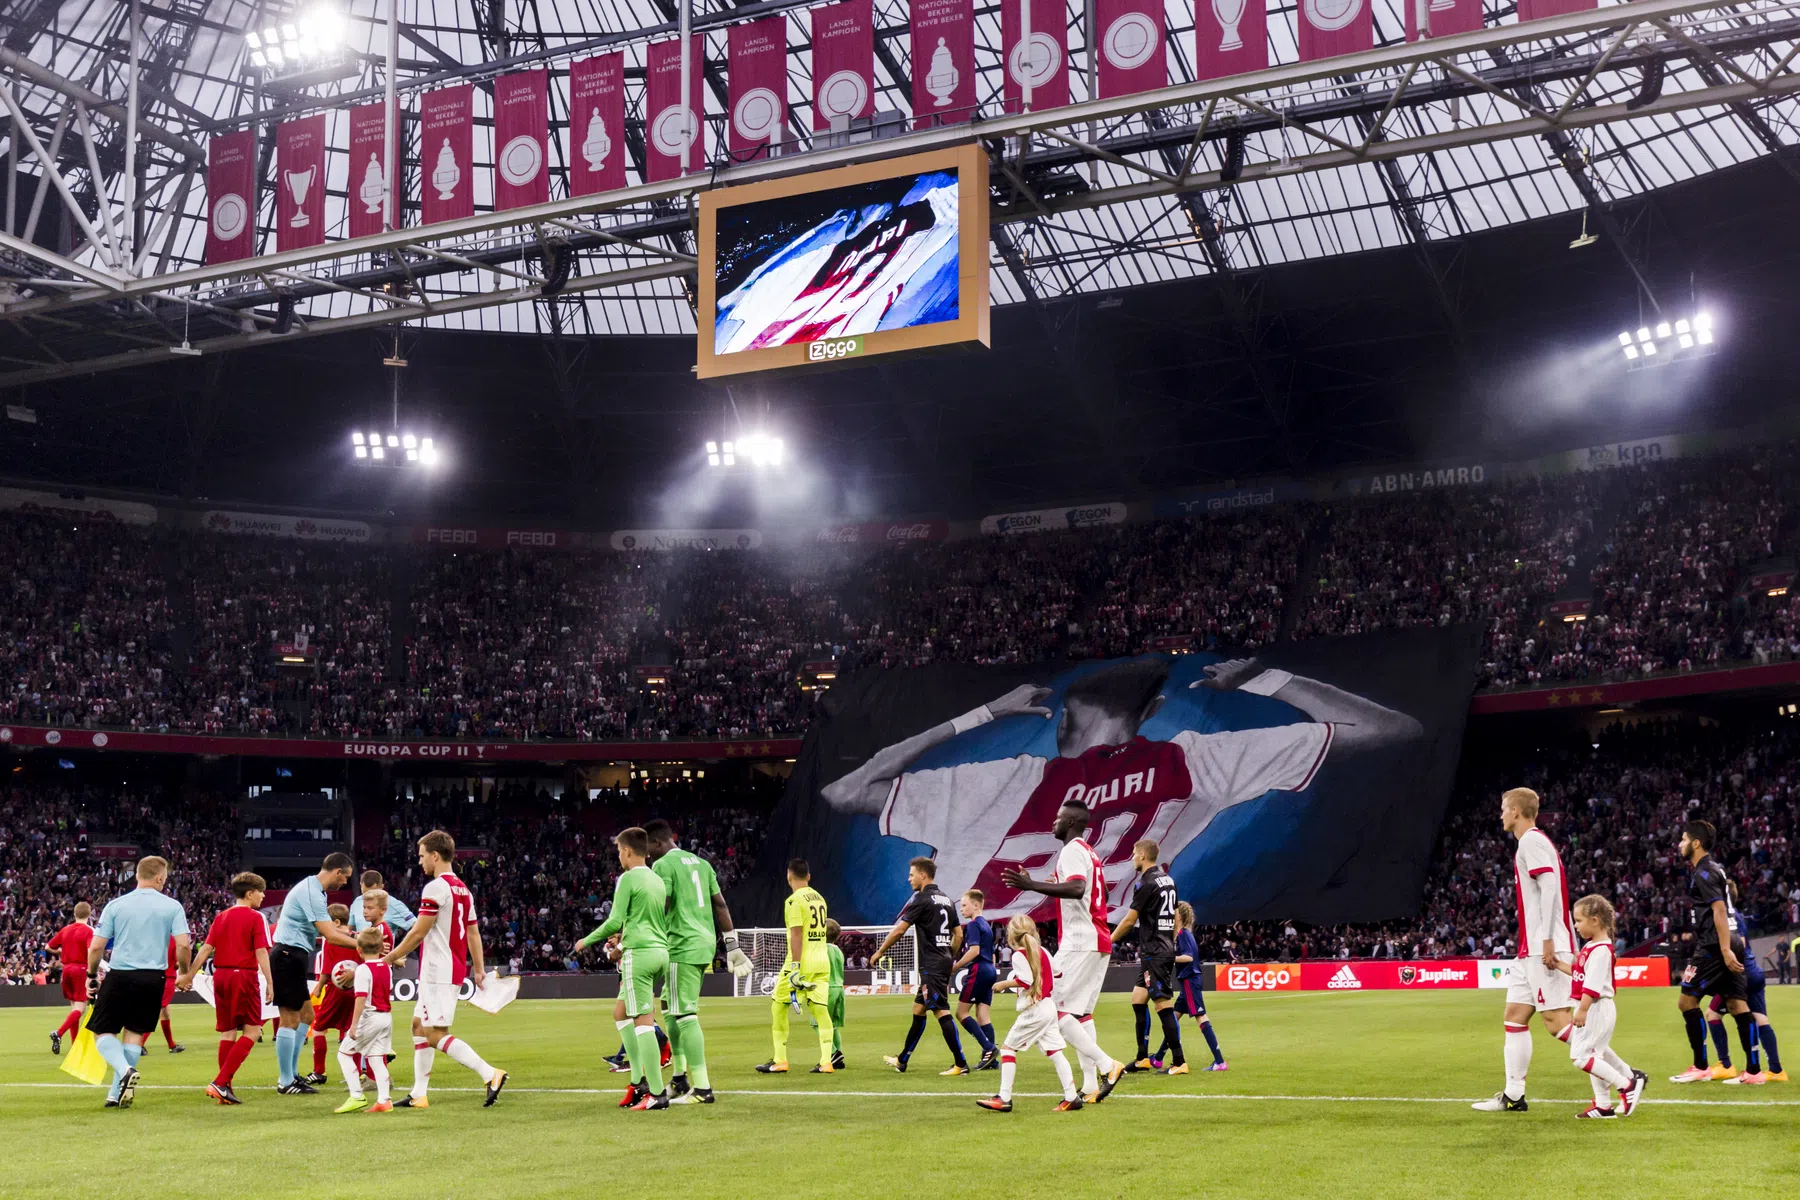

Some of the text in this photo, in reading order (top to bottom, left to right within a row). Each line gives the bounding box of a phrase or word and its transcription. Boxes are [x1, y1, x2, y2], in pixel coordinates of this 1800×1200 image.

[829, 18, 854, 29] LANDS
[917, 13, 964, 28] KNVB BEKER
[822, 26, 861, 39] KAMPIOEN
[744, 36, 768, 47] LANDS
[738, 44, 775, 57] KAMPIOEN
[663, 54, 682, 65] LAND
[577, 69, 615, 82] NATIONALE
[509, 86, 532, 97] LANDS
[575, 85, 616, 99] KNVB BEKER
[503, 94, 536, 106] KAMPIOEN
[427, 101, 465, 114] NATIONALE
[356, 118, 385, 129] NATIONA
[427, 116, 465, 130] KNVB BEKER
[289, 133, 312, 143] EUROPA
[355, 134, 372, 144] KNVB
[291, 141, 304, 150] CUP
[220, 148, 240, 157] LANDS
[215, 154, 244, 165] KAMPIOEN
[1618, 442, 1661, 464] kpn
[1207, 487, 1274, 510] randstad
[1074, 508, 1112, 521] AEGON
[235, 519, 281, 531] HUAWEI
[1004, 515, 1042, 529] AEGON
[320, 526, 366, 537] HUAWEI
[427, 528, 477, 544] FEBO
[507, 531, 556, 546] FEBO
[344, 744, 412, 756] EUROPA
[418, 745, 451, 757] CUP
[457, 746, 468, 756] II
[691, 870, 705, 908] 1
[1095, 867, 1102, 907] 5
[1159, 889, 1176, 916] 20
[809, 904, 827, 929] 30
[939, 908, 950, 934] 2
[1228, 966, 1290, 989] Ziggo
[1327, 979, 1362, 989] adidas
[1537, 987, 1546, 1006] 4
